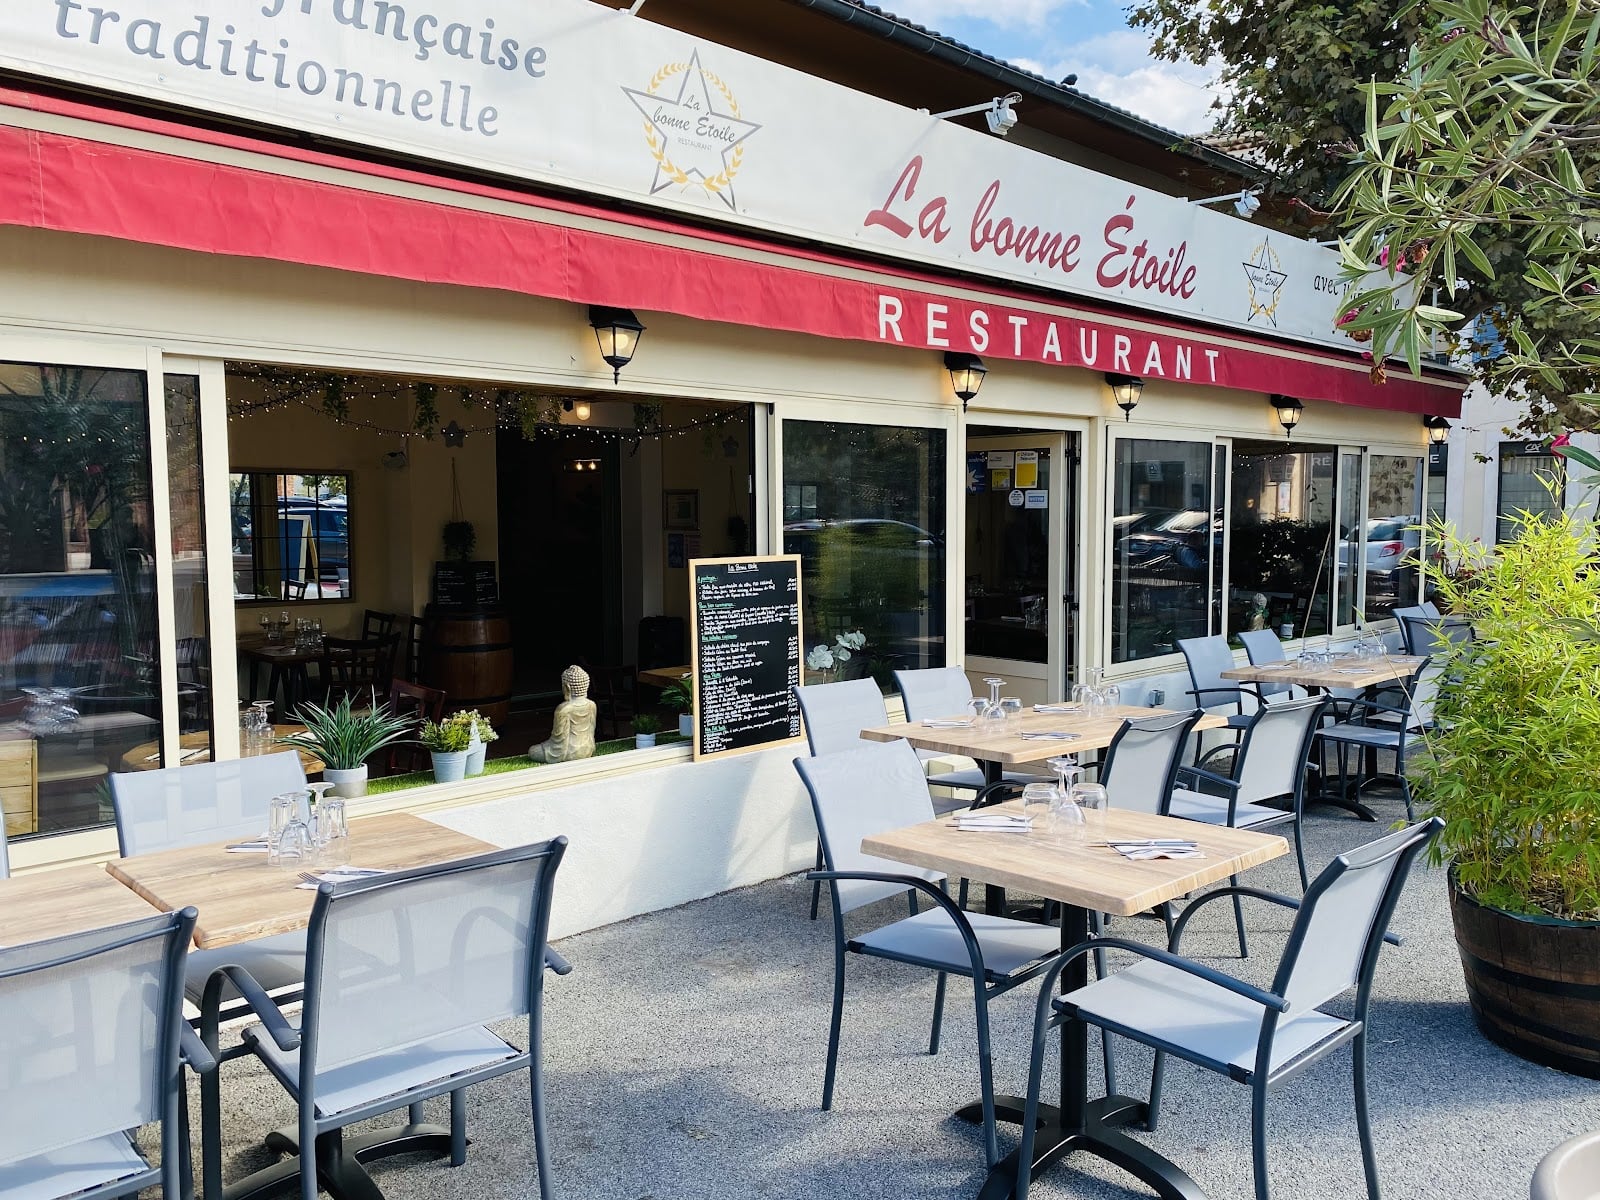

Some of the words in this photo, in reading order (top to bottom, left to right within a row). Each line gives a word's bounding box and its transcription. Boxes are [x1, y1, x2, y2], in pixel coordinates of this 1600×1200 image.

[54, 0, 499, 137] traditionnelle
[261, 0, 547, 78] ançaise
[653, 107, 690, 130] bonne
[696, 111, 735, 143] Étoile
[683, 95, 701, 110] La
[677, 137, 713, 151] RESTAURANT
[864, 155, 951, 244] La
[969, 180, 1081, 273] bonne
[1096, 195, 1198, 300] Étoile
[878, 293, 1221, 383] RESTAURANT
